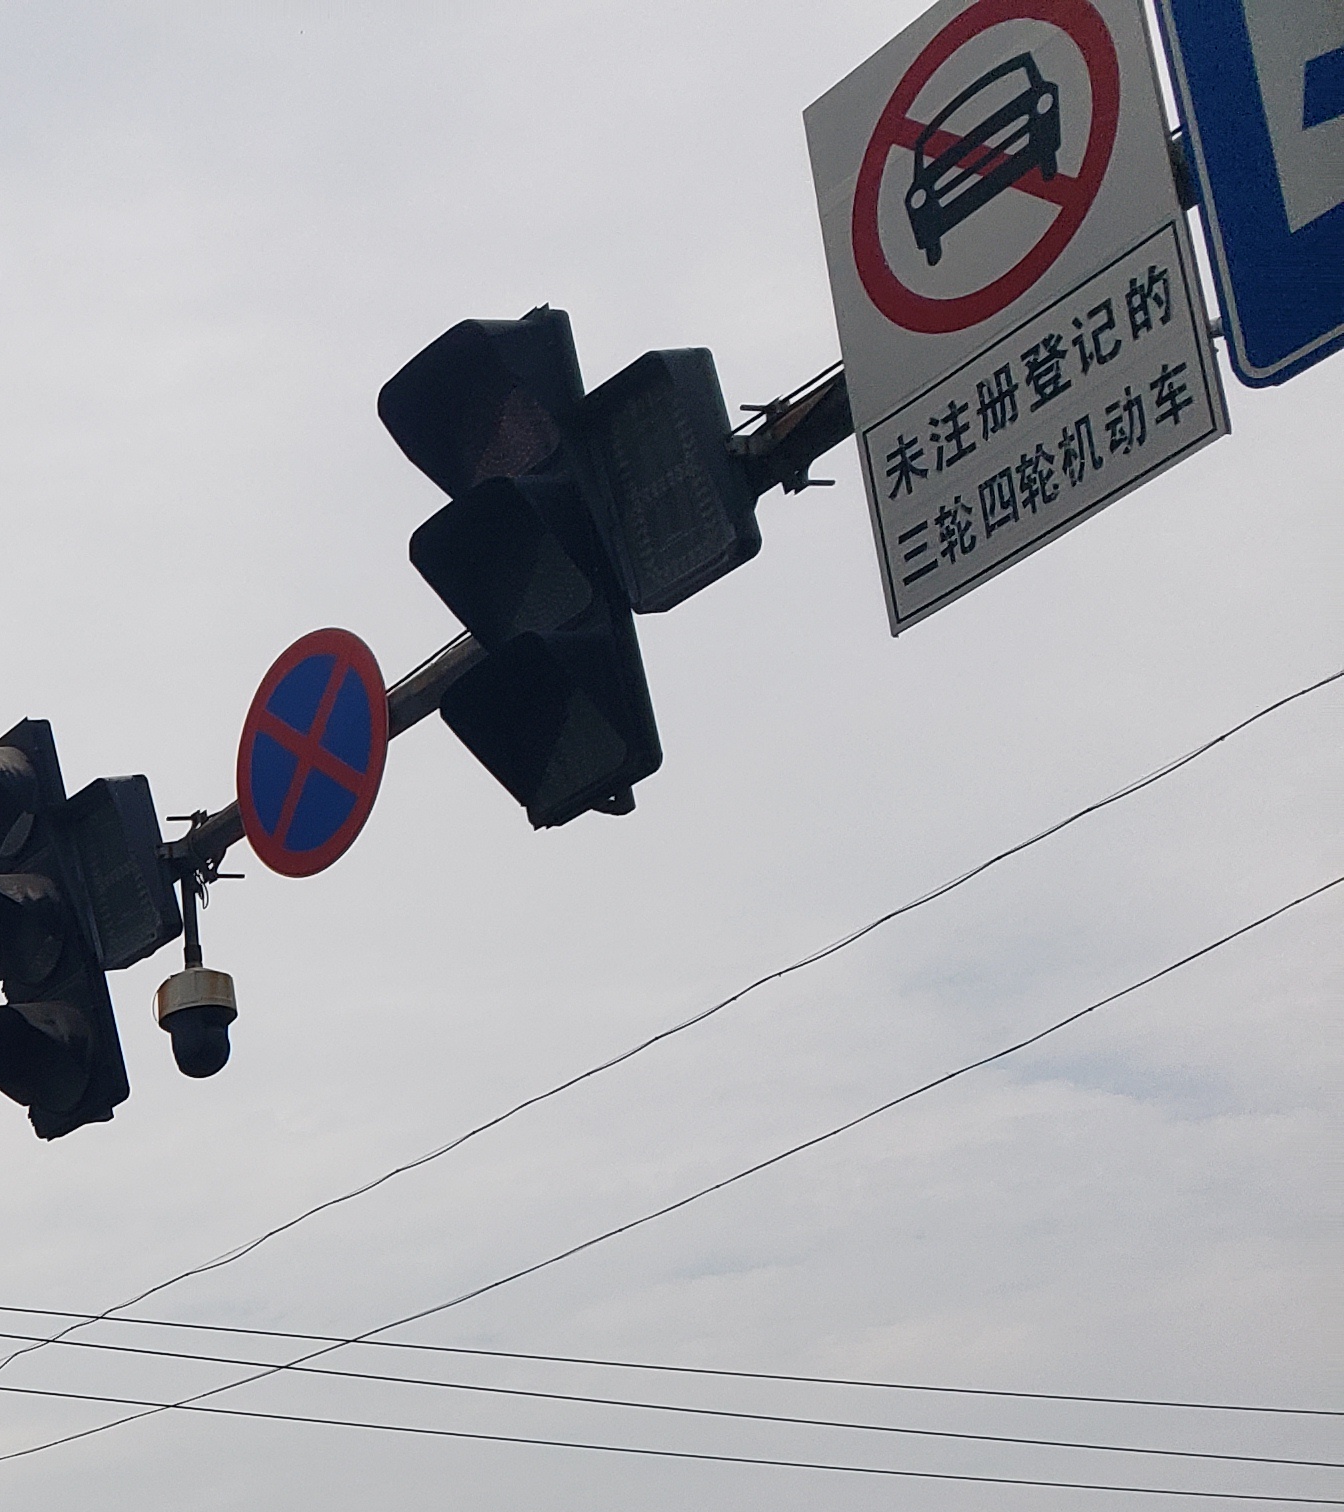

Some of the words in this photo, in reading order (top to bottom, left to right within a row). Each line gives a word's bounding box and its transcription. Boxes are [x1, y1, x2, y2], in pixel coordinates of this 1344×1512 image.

[885, 264, 1173, 500] 未注册登记的
[897, 361, 1195, 587] 三轮四轮机动车
